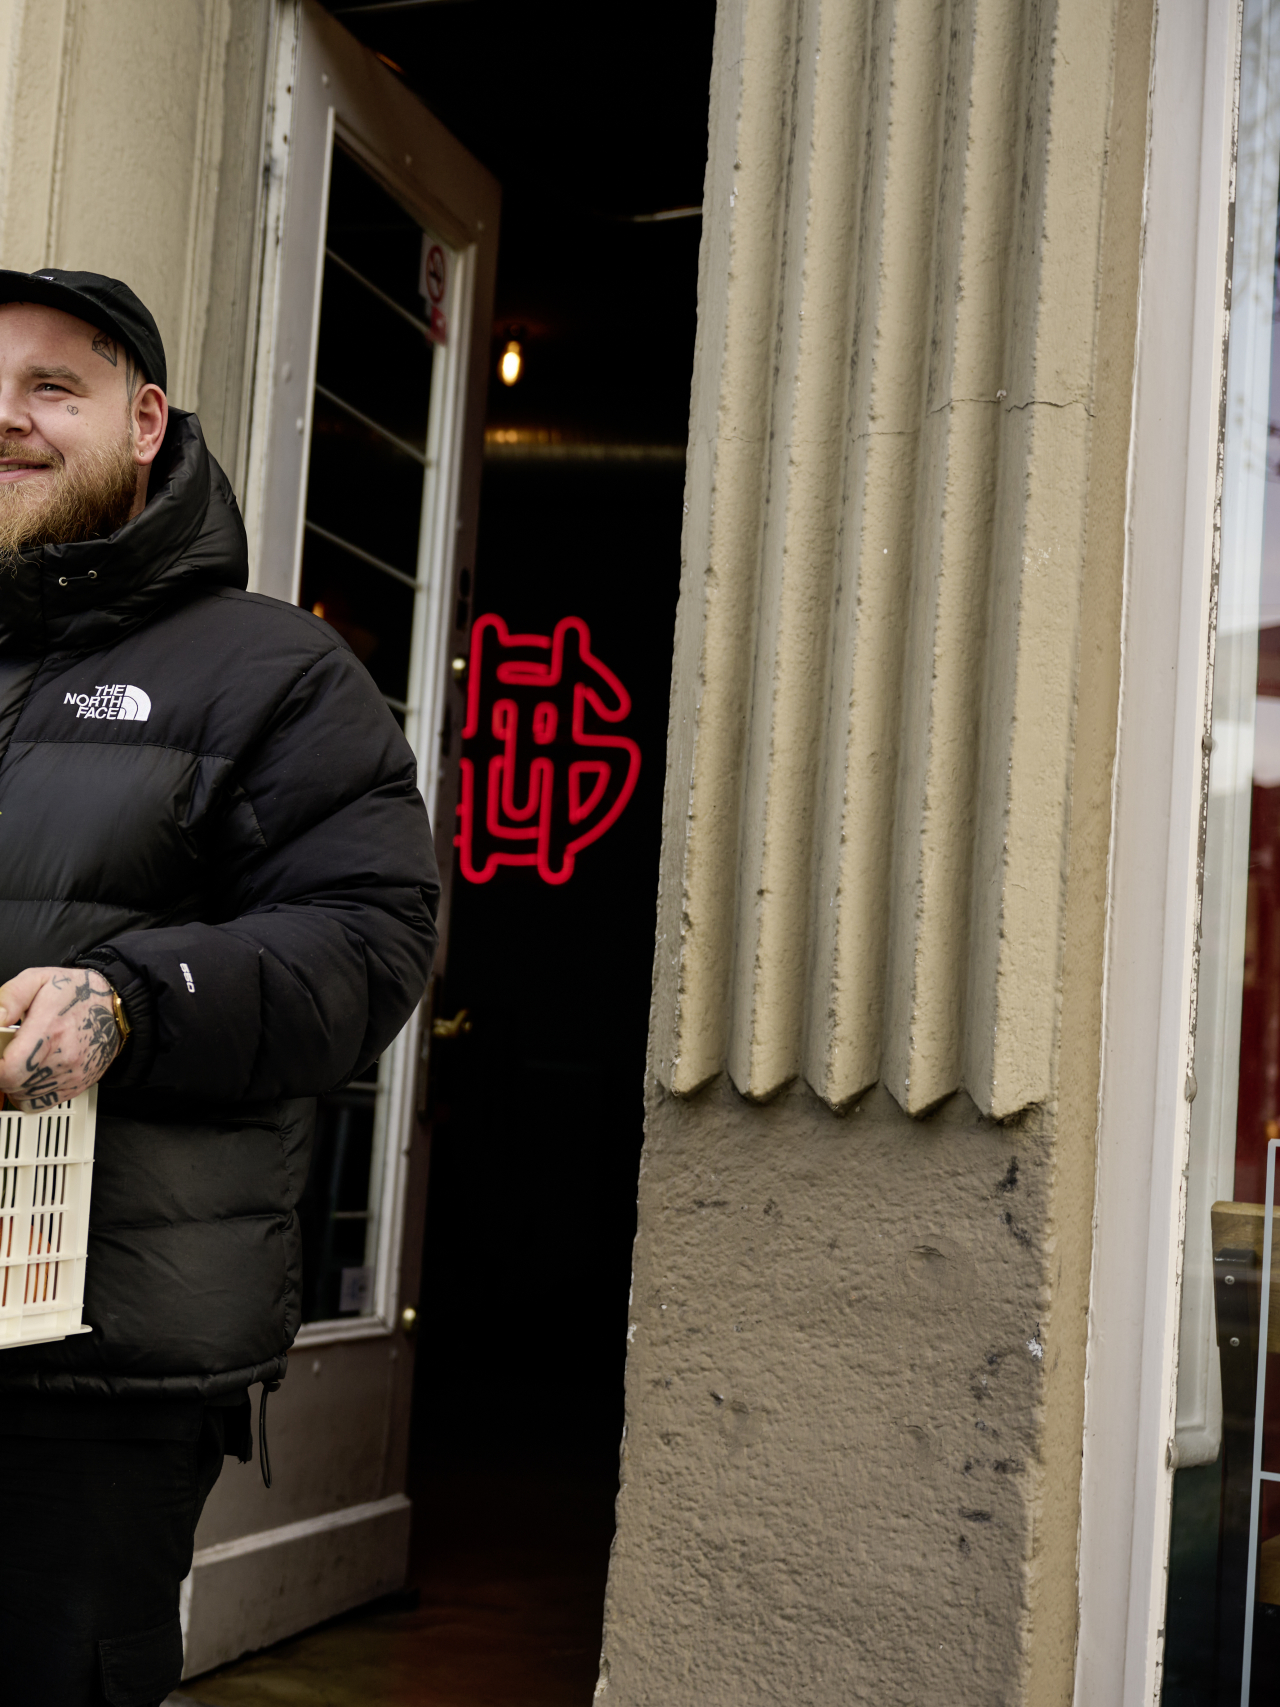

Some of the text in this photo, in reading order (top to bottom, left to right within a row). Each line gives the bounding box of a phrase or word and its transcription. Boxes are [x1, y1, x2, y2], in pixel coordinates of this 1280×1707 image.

[95, 684, 126, 696] THE
[63, 692, 122, 708] NORTH
[76, 706, 119, 720] FACE
